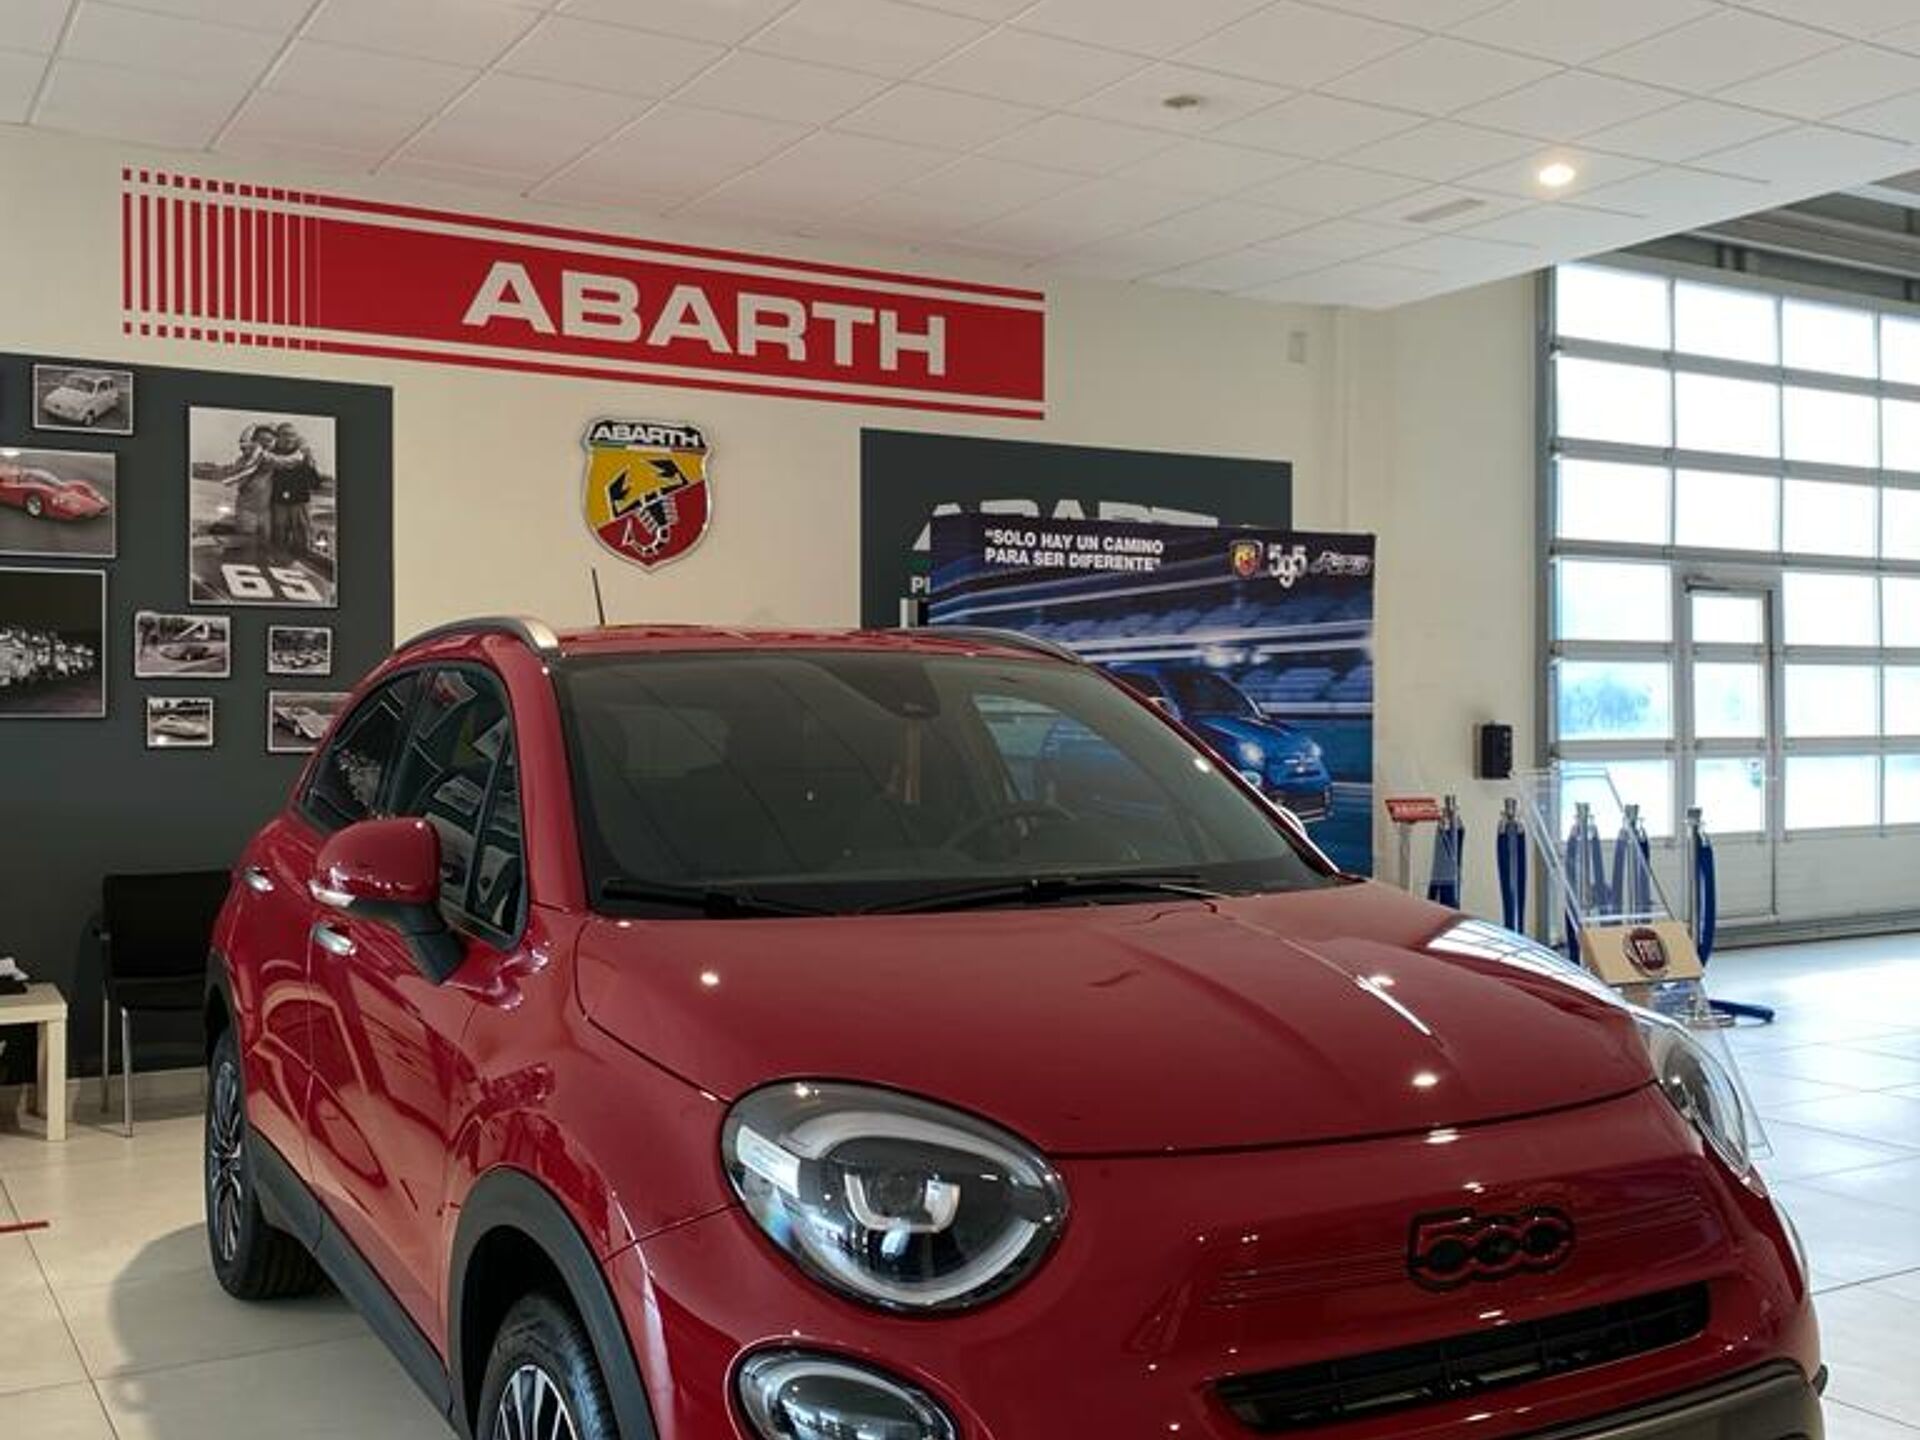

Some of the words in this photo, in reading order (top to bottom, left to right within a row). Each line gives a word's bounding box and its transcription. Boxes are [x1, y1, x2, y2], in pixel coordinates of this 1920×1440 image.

[462, 261, 946, 376] ABARTH
[594, 424, 699, 446] ABARTH
[985, 529, 1036, 547] "SOLO
[1041, 533, 1073, 549] HAY
[1077, 534, 1098, 550] UN
[1103, 536, 1164, 554] CAMINO
[984, 547, 1029, 564] PARA
[1033, 550, 1064, 567] SER
[221, 564, 322, 600] 65
[1406, 1206, 1576, 1293] 500
